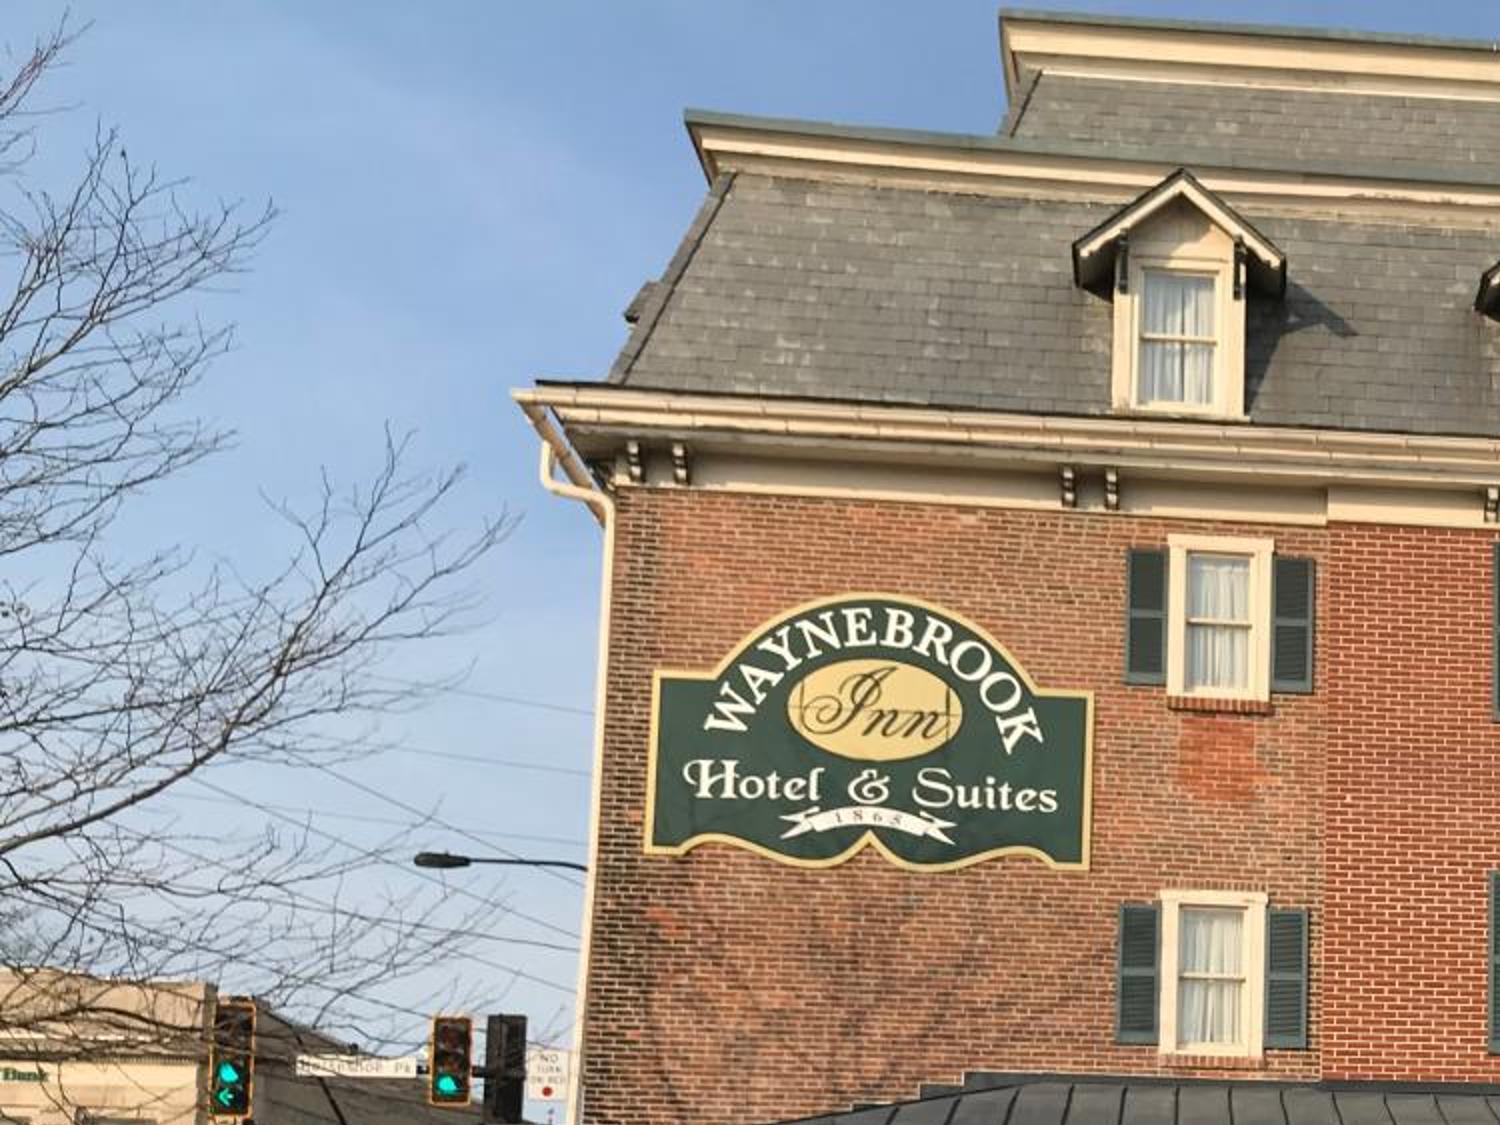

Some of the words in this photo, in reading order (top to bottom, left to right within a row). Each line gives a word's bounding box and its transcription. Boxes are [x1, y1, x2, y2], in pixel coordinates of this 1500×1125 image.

[704, 607, 1044, 755] WAYNEBROOK
[801, 666, 947, 741] Inn
[682, 758, 824, 801] Hotel
[848, 768, 890, 804] &
[912, 767, 1058, 812] Suites
